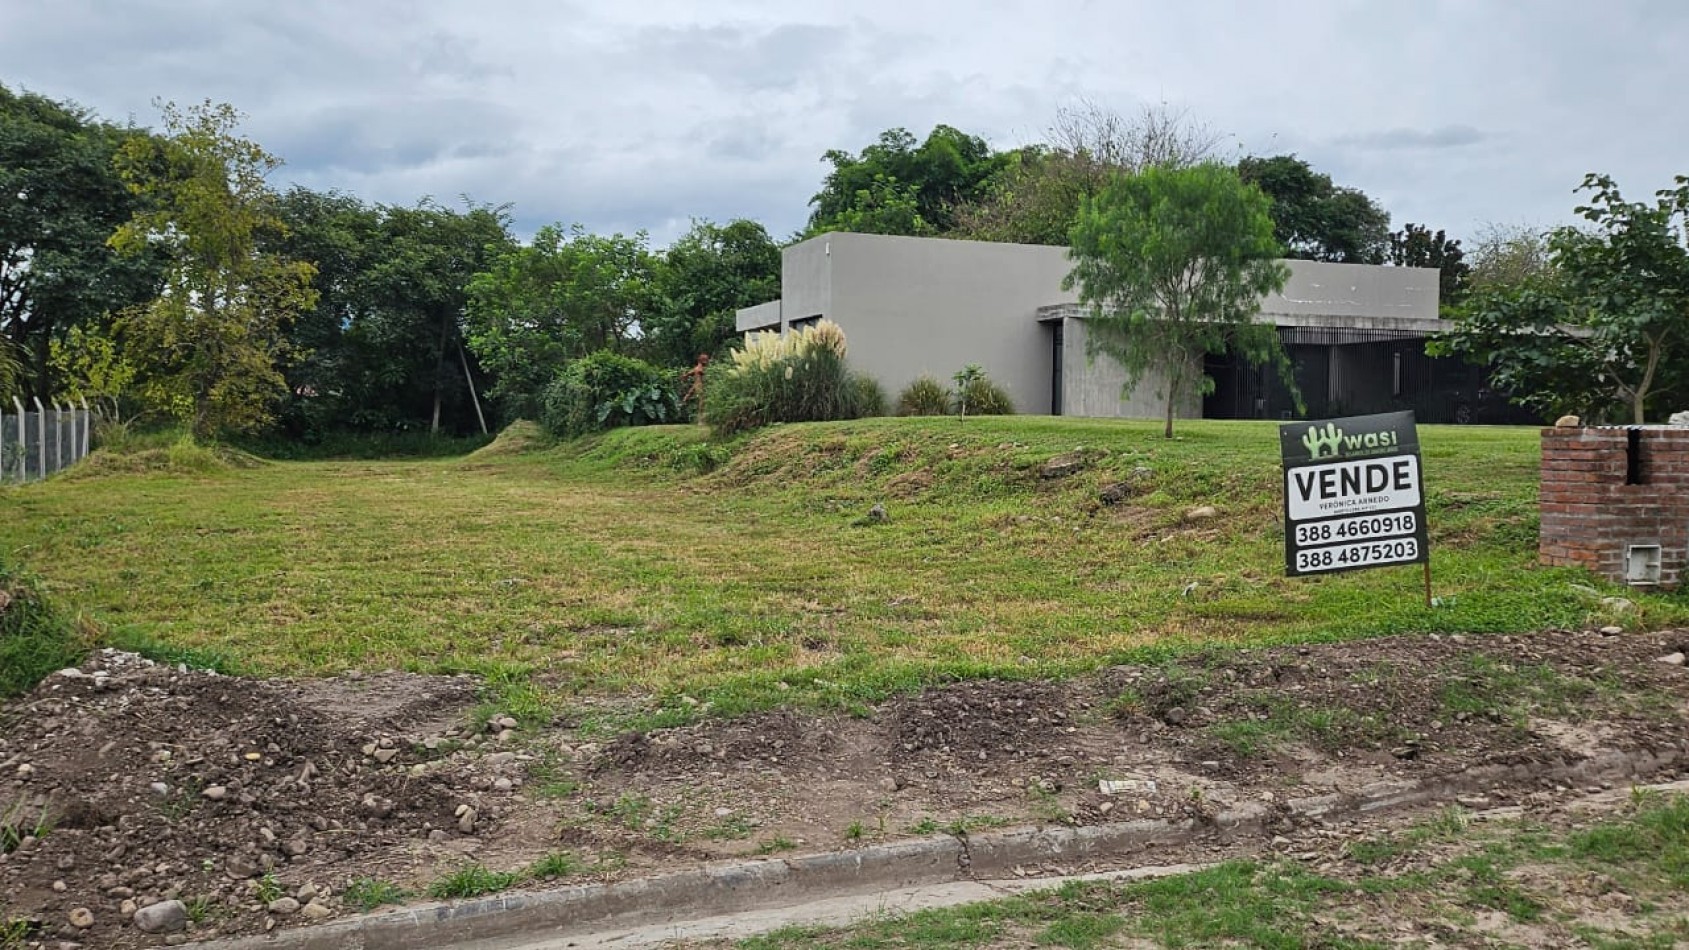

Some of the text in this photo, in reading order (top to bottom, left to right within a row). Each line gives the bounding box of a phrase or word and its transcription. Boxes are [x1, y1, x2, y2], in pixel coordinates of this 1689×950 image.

[1344, 430, 1397, 450] wasi
[1294, 460, 1412, 502] VENDE
[1298, 516, 1414, 542] 388 4660918
[1299, 541, 1416, 568] 388 4875203
